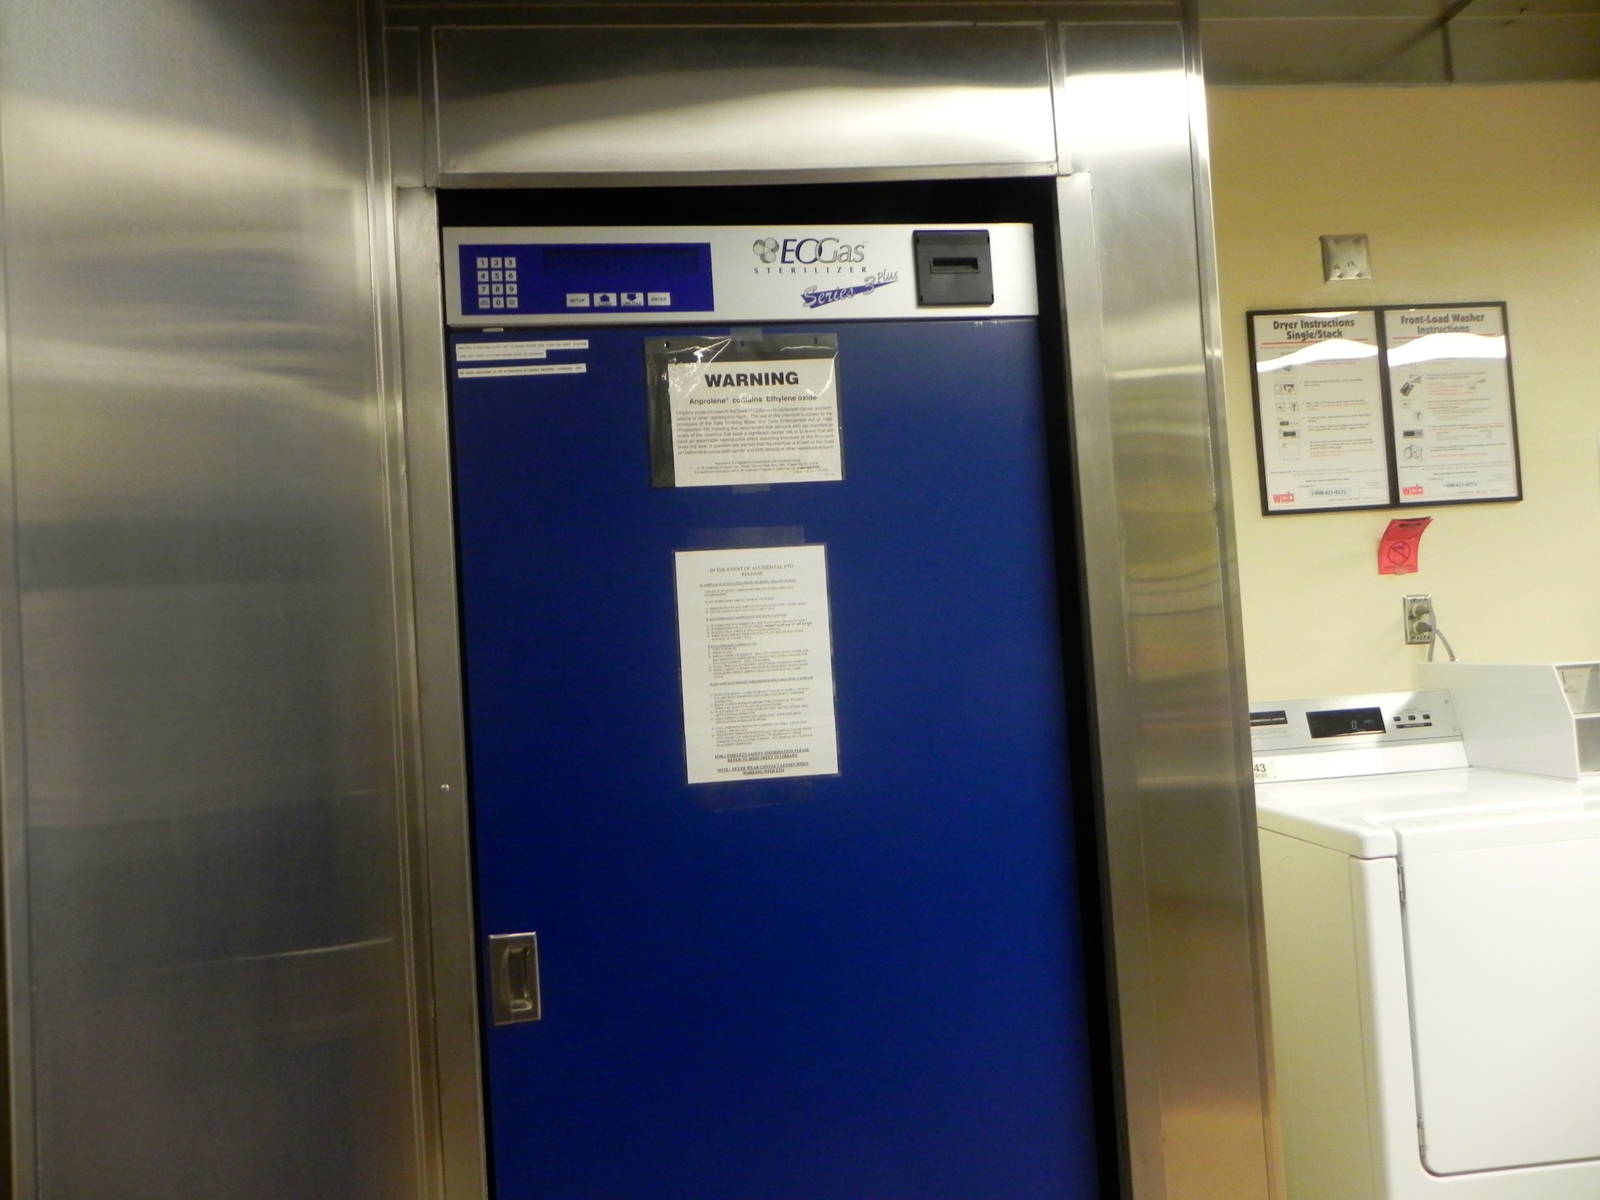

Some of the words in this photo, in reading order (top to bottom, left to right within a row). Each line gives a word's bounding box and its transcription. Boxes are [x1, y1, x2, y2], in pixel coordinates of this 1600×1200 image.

[753, 267, 868, 275] STERILIZER
[801, 283, 855, 307] Series
[863, 276, 876, 295] 3
[1273, 321, 1297, 331] Dryer
[1300, 318, 1355, 329] Instructions
[1401, 314, 1448, 325] Front-Load
[1452, 313, 1485, 322] Washer
[1417, 324, 1469, 334] Instructions
[1286, 329, 1343, 342] Single/Stack
[705, 371, 799, 388] WARNING
[766, 395, 796, 404] Ethylene
